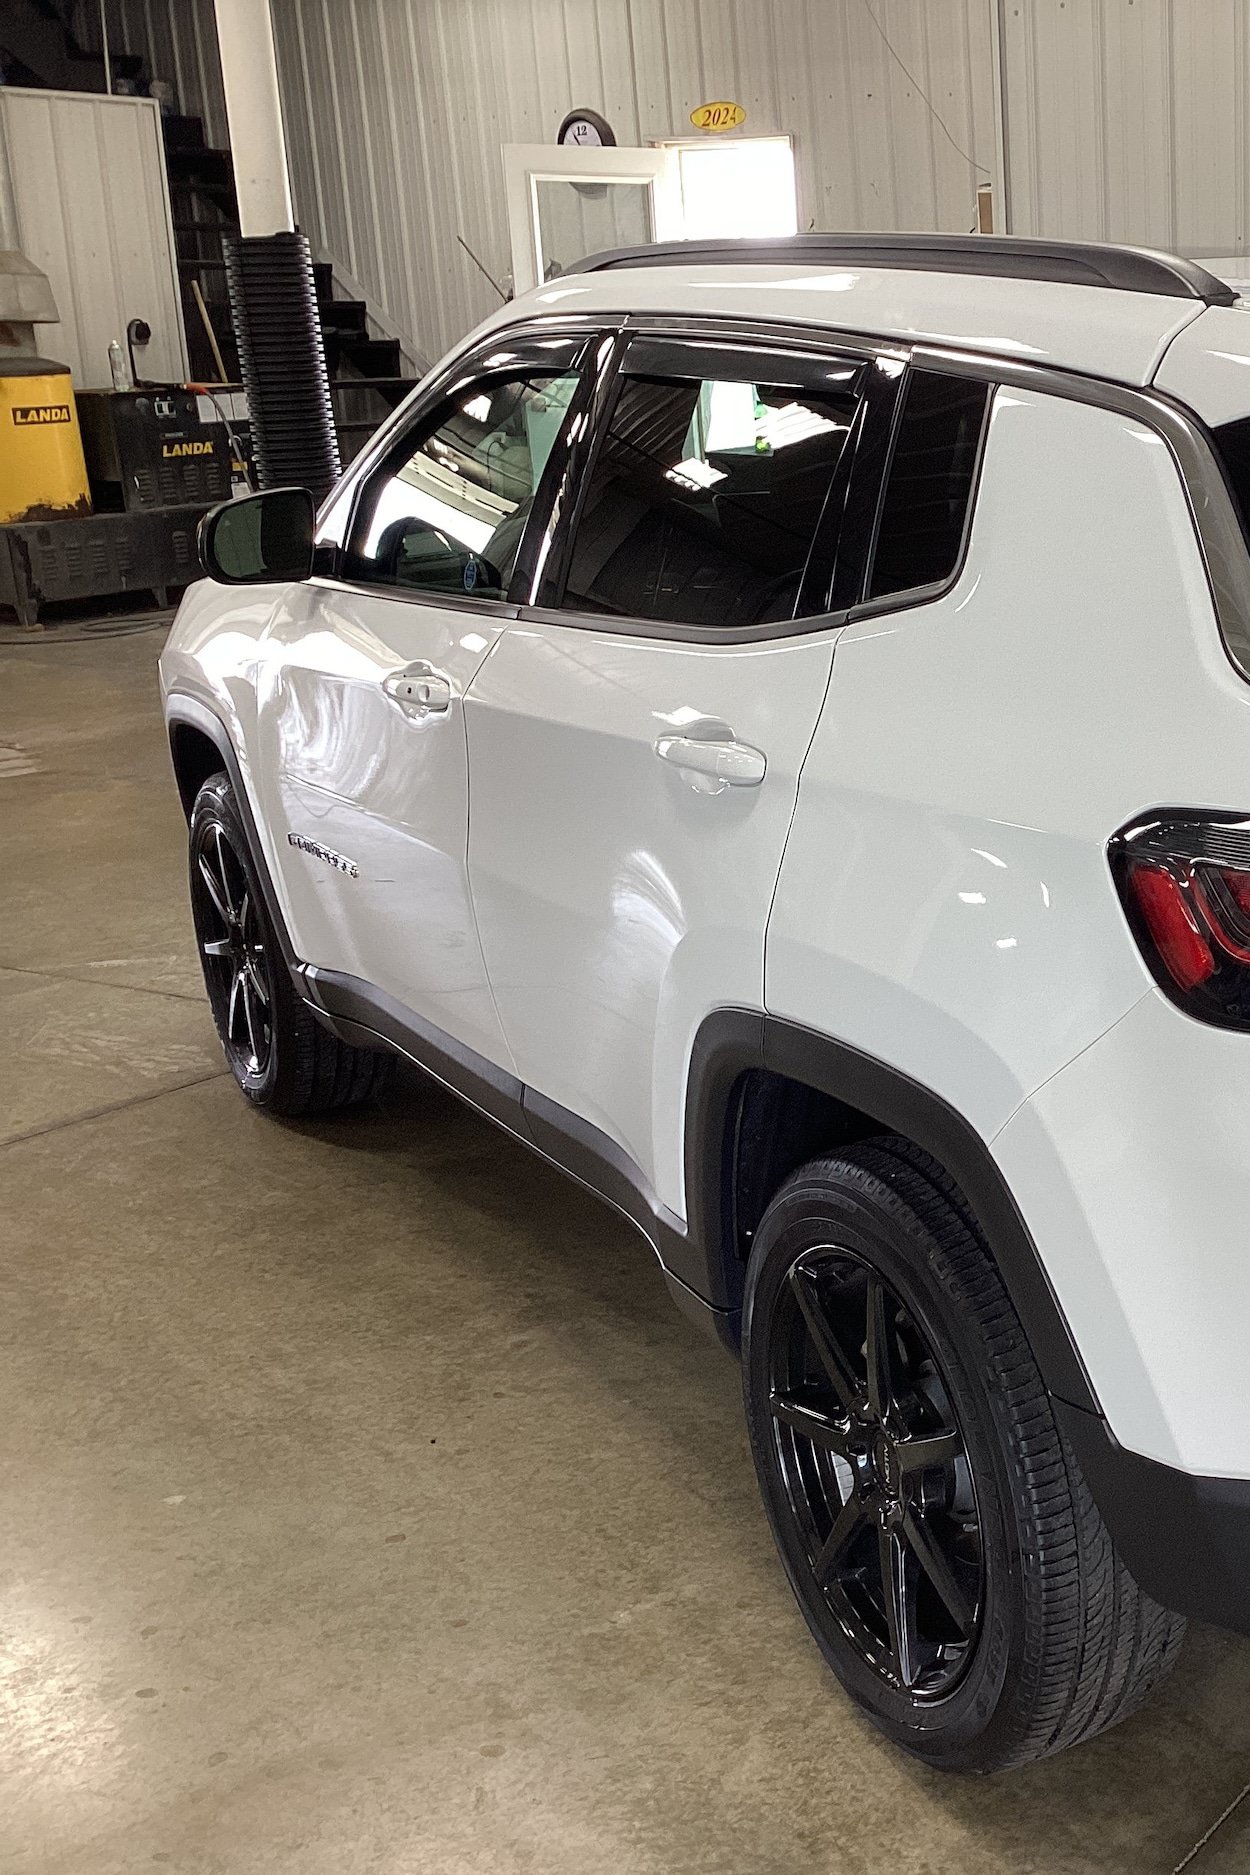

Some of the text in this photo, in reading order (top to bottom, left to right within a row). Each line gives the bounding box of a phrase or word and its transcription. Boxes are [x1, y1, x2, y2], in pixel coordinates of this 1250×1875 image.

[702, 106, 737, 127] 2024
[576, 125, 588, 136] 12
[15, 407, 69, 423] LANDA
[162, 441, 214, 458] LANDA
